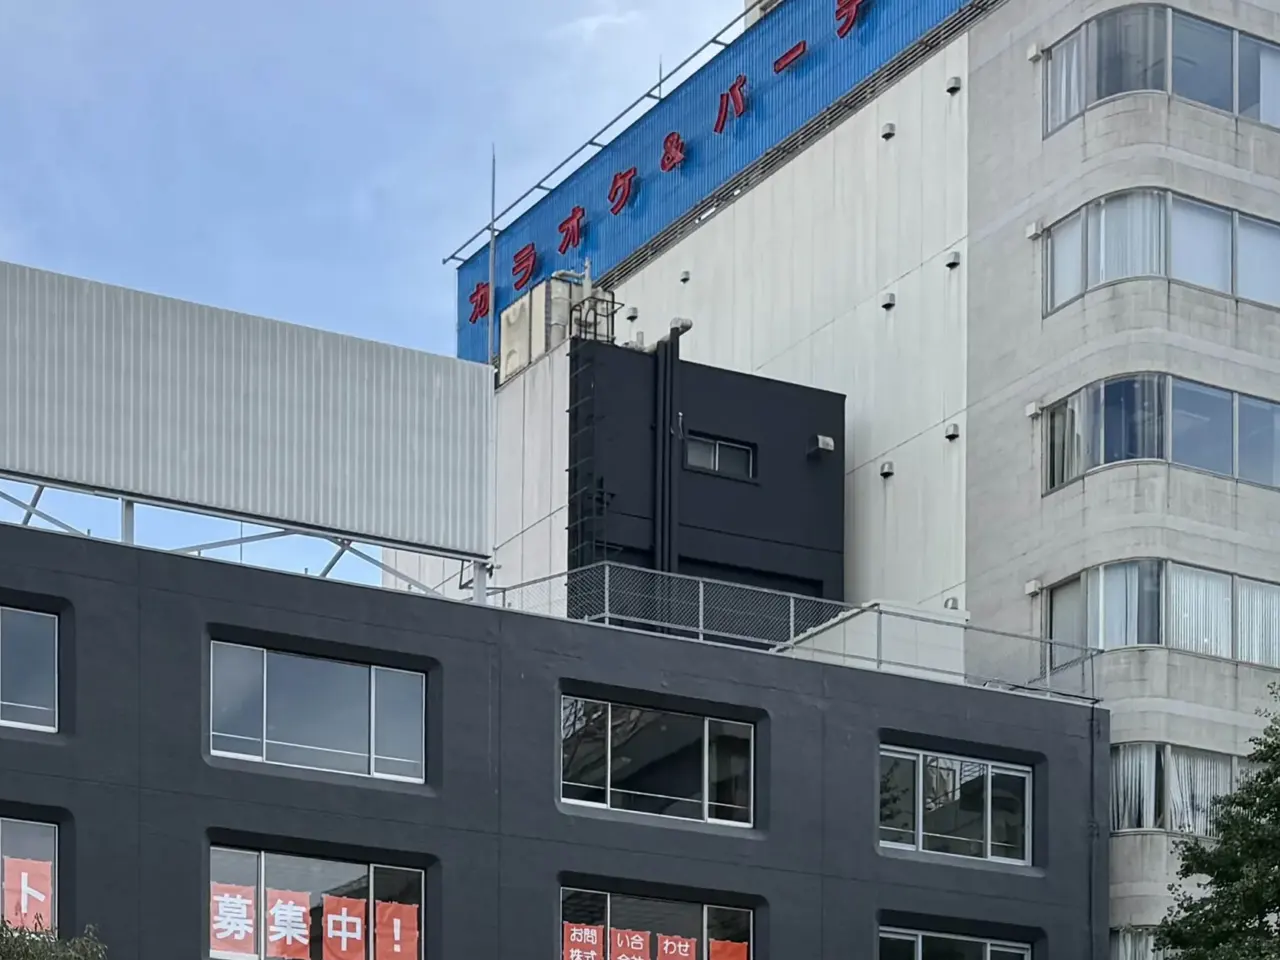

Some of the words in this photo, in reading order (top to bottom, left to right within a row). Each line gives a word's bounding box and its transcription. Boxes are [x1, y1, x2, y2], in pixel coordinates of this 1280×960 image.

[212, 894, 402, 953] 募集中!
[569, 928, 690, 957] お問い合わせ
